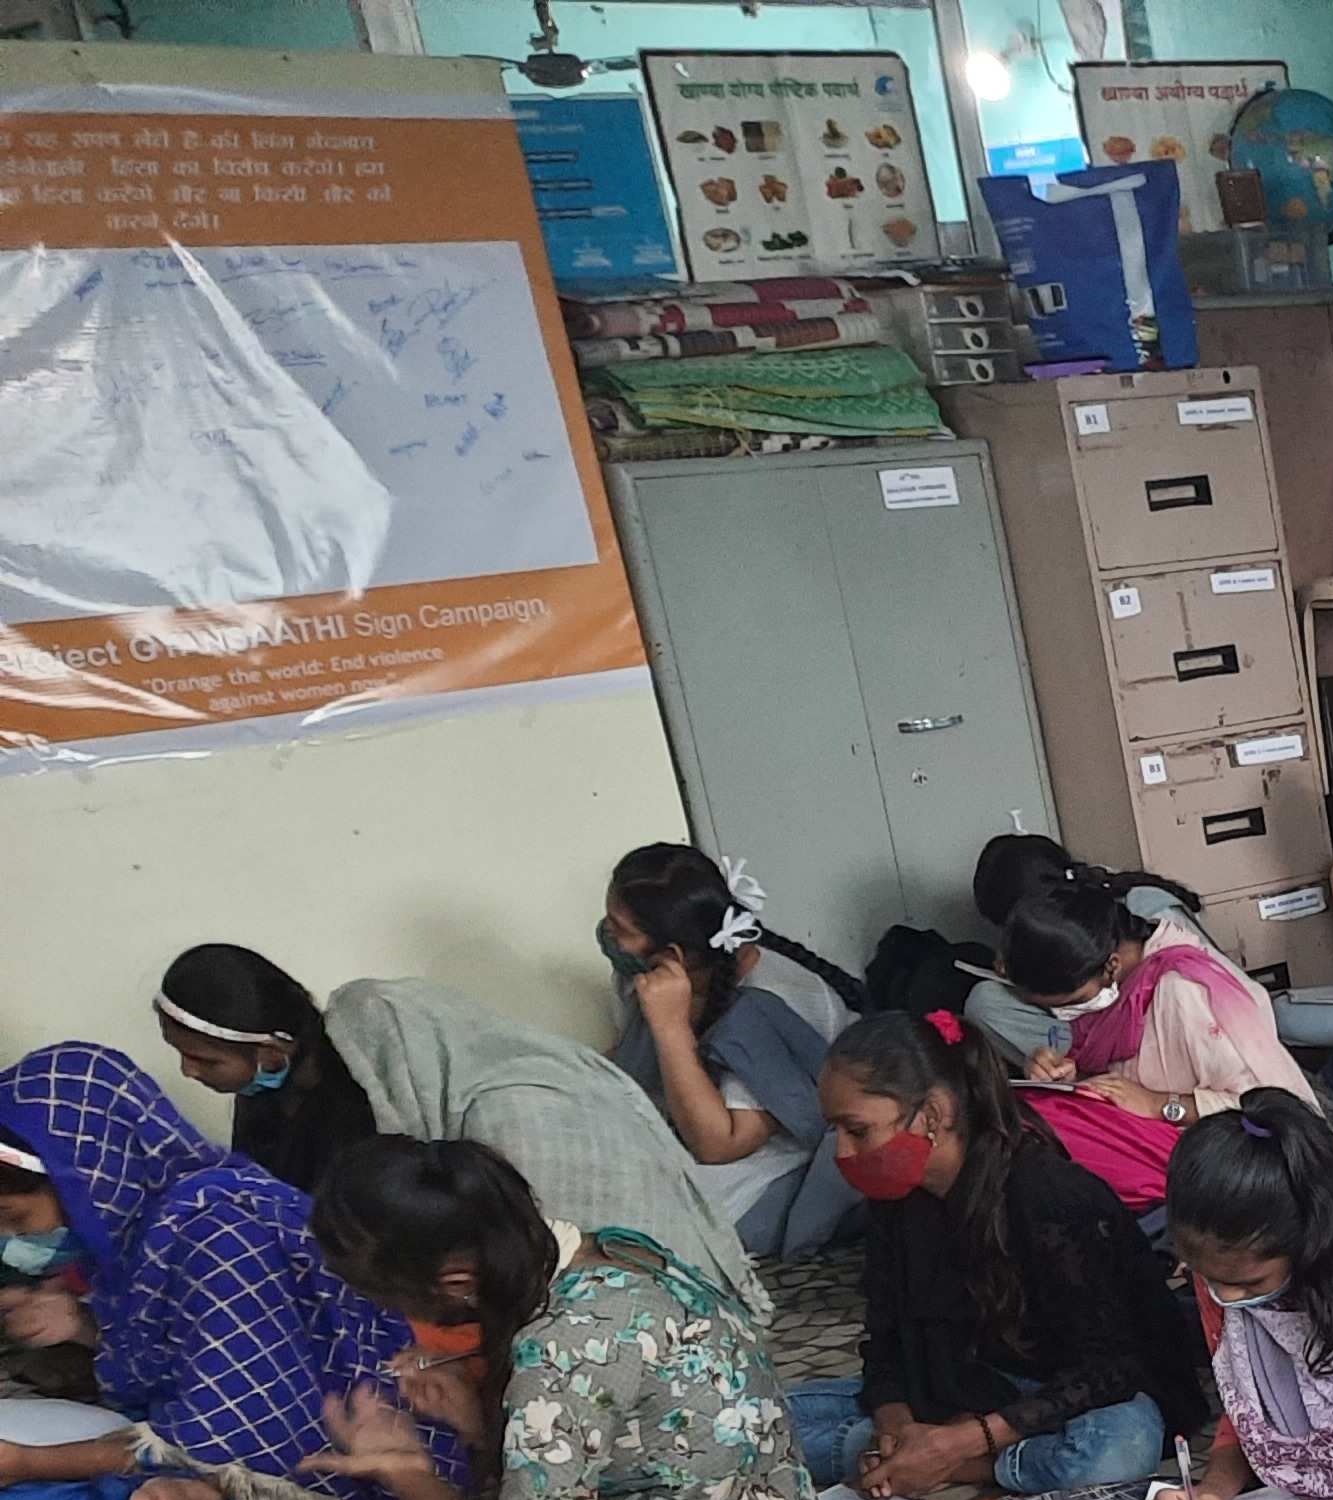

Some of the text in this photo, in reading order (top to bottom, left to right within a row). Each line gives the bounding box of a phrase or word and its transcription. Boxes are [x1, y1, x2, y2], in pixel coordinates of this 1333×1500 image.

[354, 612, 412, 640] Sign
[229, 667, 262, 686] the
[266, 661, 325, 684] world:
[331, 653, 367, 673] End
[369, 646, 445, 667] violence
[208, 691, 276, 713] against
[281, 683, 346, 701] women
